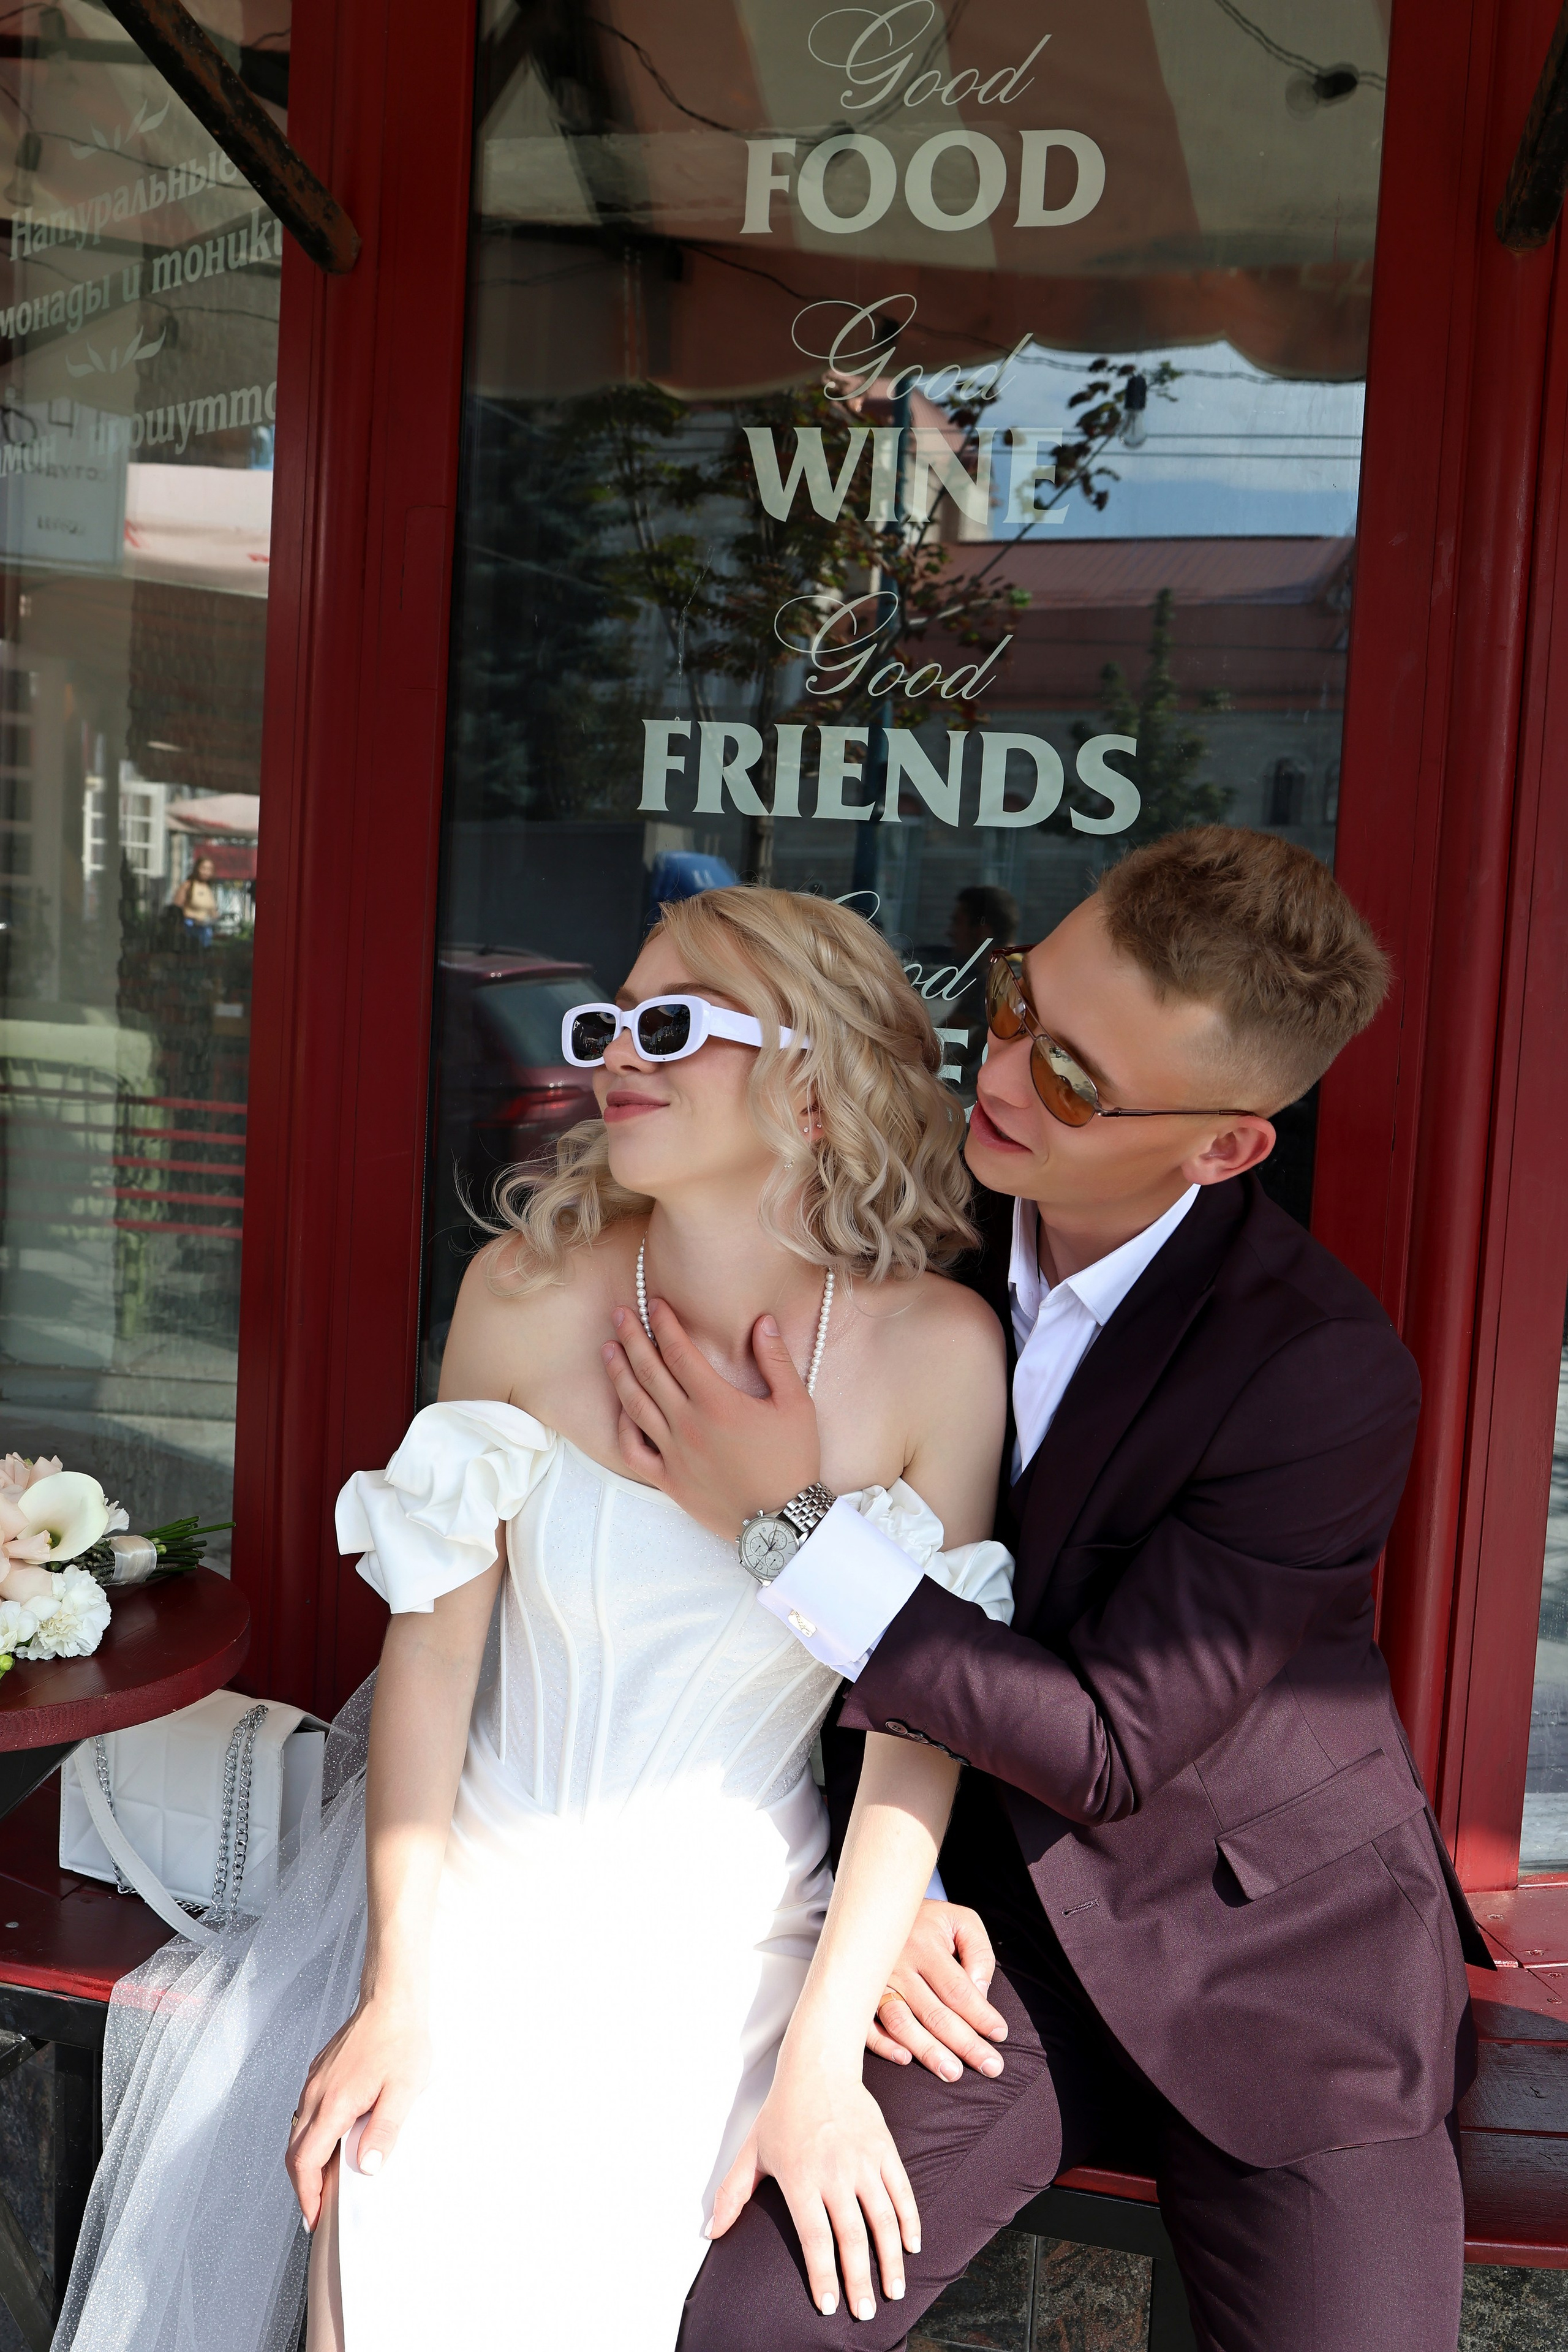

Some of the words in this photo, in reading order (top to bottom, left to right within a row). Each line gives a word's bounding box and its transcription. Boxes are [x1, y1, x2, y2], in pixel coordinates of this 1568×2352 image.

[808, 0, 1052, 110] Good
[10, 150, 238, 262] Натуральные
[739, 129, 1106, 234] FOOD
[123, 264, 140, 303] и
[791, 293, 1033, 402] Good
[0, 432, 58, 478] мон
[742, 427, 1071, 526] WINE
[774, 590, 1014, 699] Good
[636, 718, 1142, 835] FRIENDS
